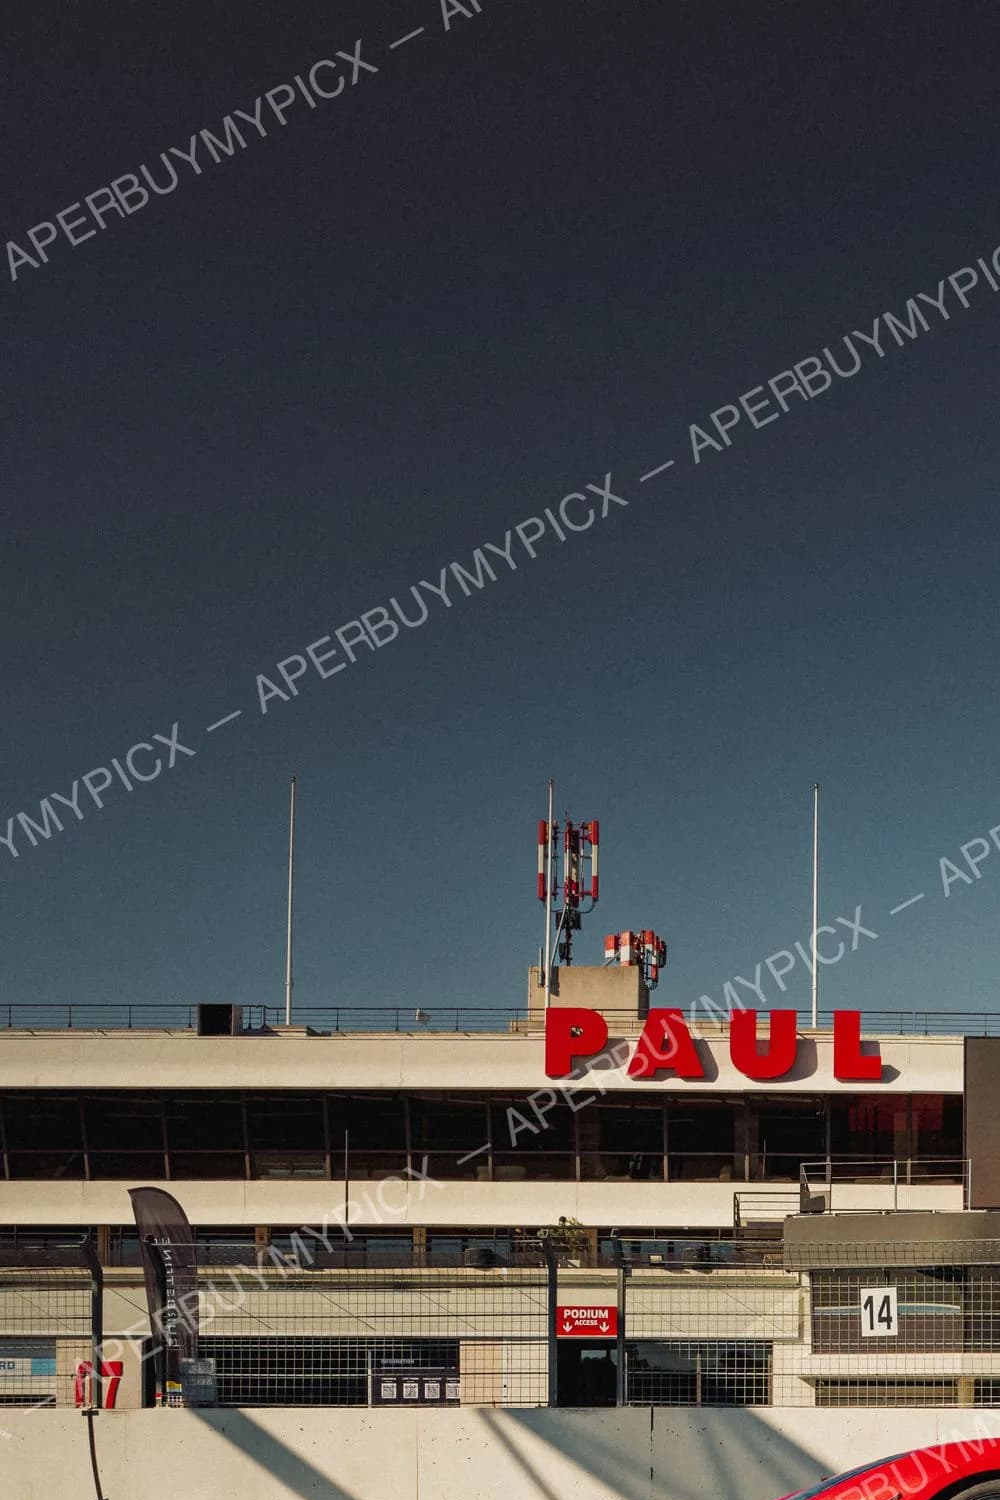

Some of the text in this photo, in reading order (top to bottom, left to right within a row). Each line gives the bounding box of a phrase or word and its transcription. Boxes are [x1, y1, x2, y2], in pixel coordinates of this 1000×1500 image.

[545, 1008, 881, 1080] PAUL
[563, 1309, 608, 1319] PODIUM
[864, 1295, 893, 1331] 14
